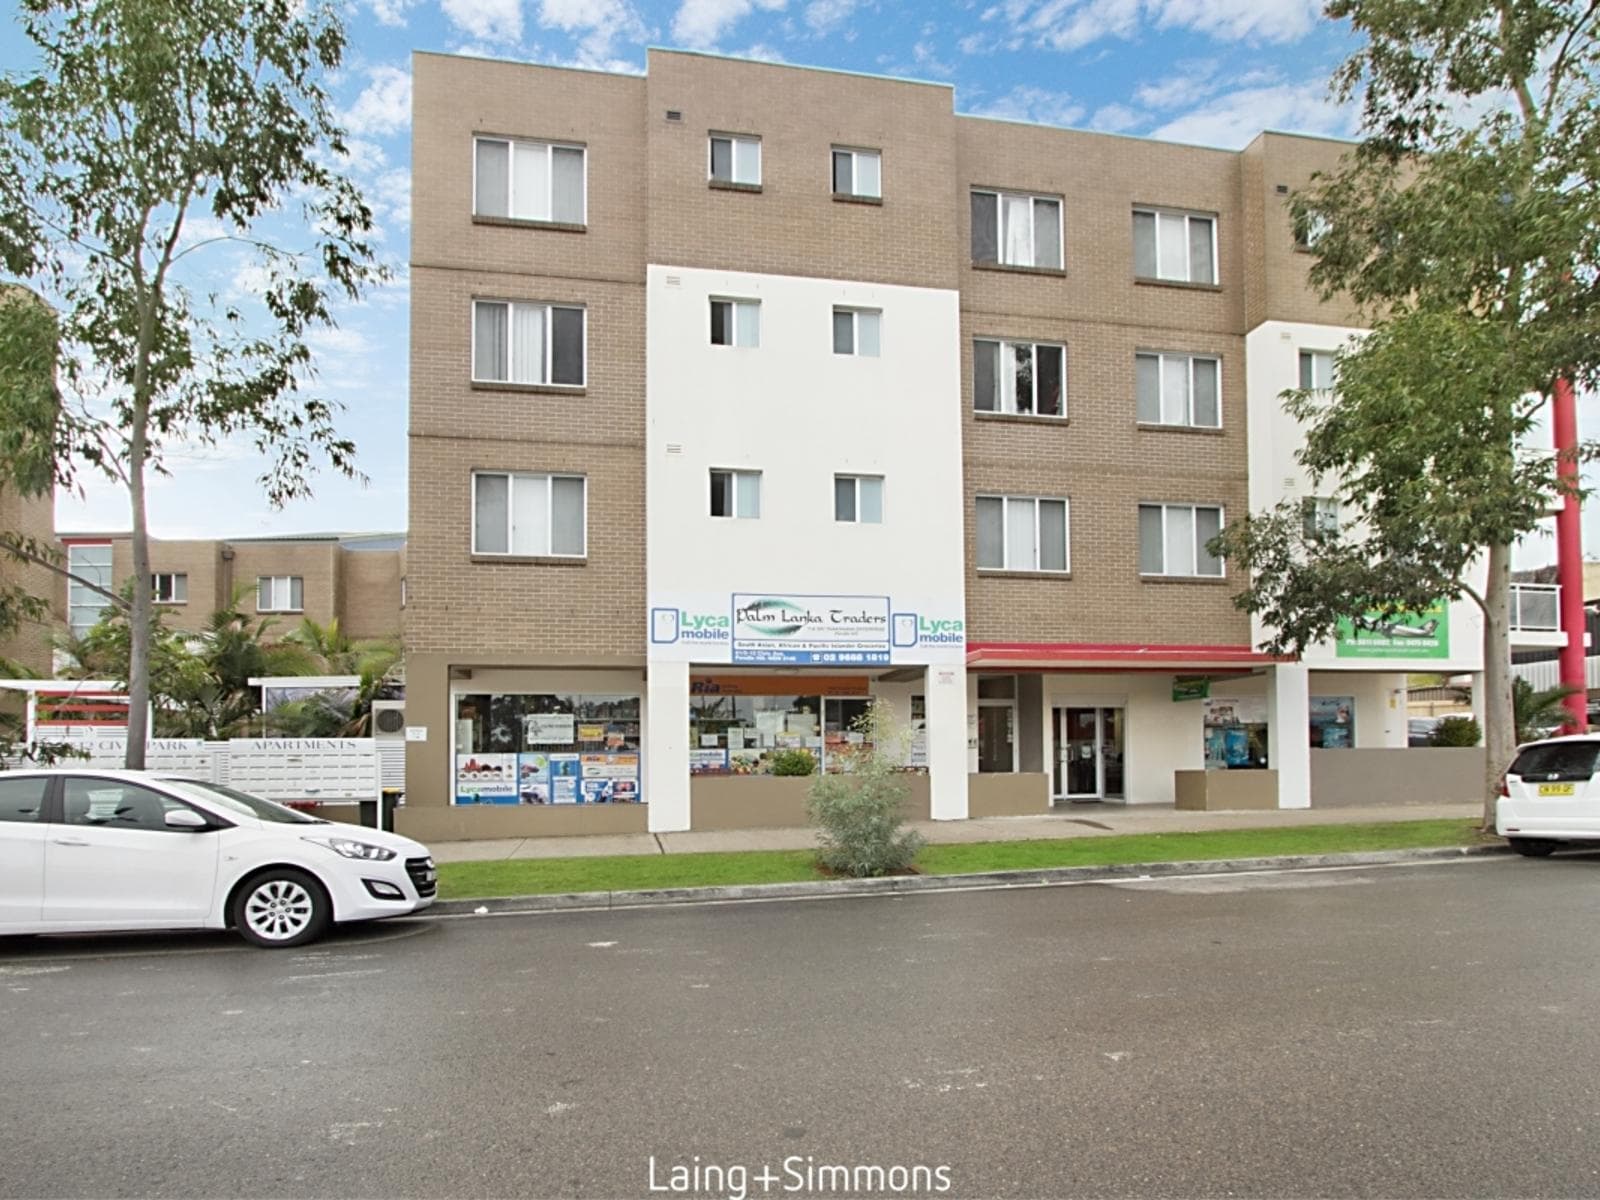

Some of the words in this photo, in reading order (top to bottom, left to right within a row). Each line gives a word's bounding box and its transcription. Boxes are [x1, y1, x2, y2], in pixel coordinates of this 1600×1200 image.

[681, 611, 729, 629] Lyca
[736, 608, 776, 624] Palm
[781, 610, 823, 624] Lanka
[829, 610, 886, 624] Traders
[919, 616, 963, 634] Lyca
[681, 629, 729, 640] mobile
[919, 632, 963, 643] mobile
[252, 741, 356, 750] APARTMENTS
